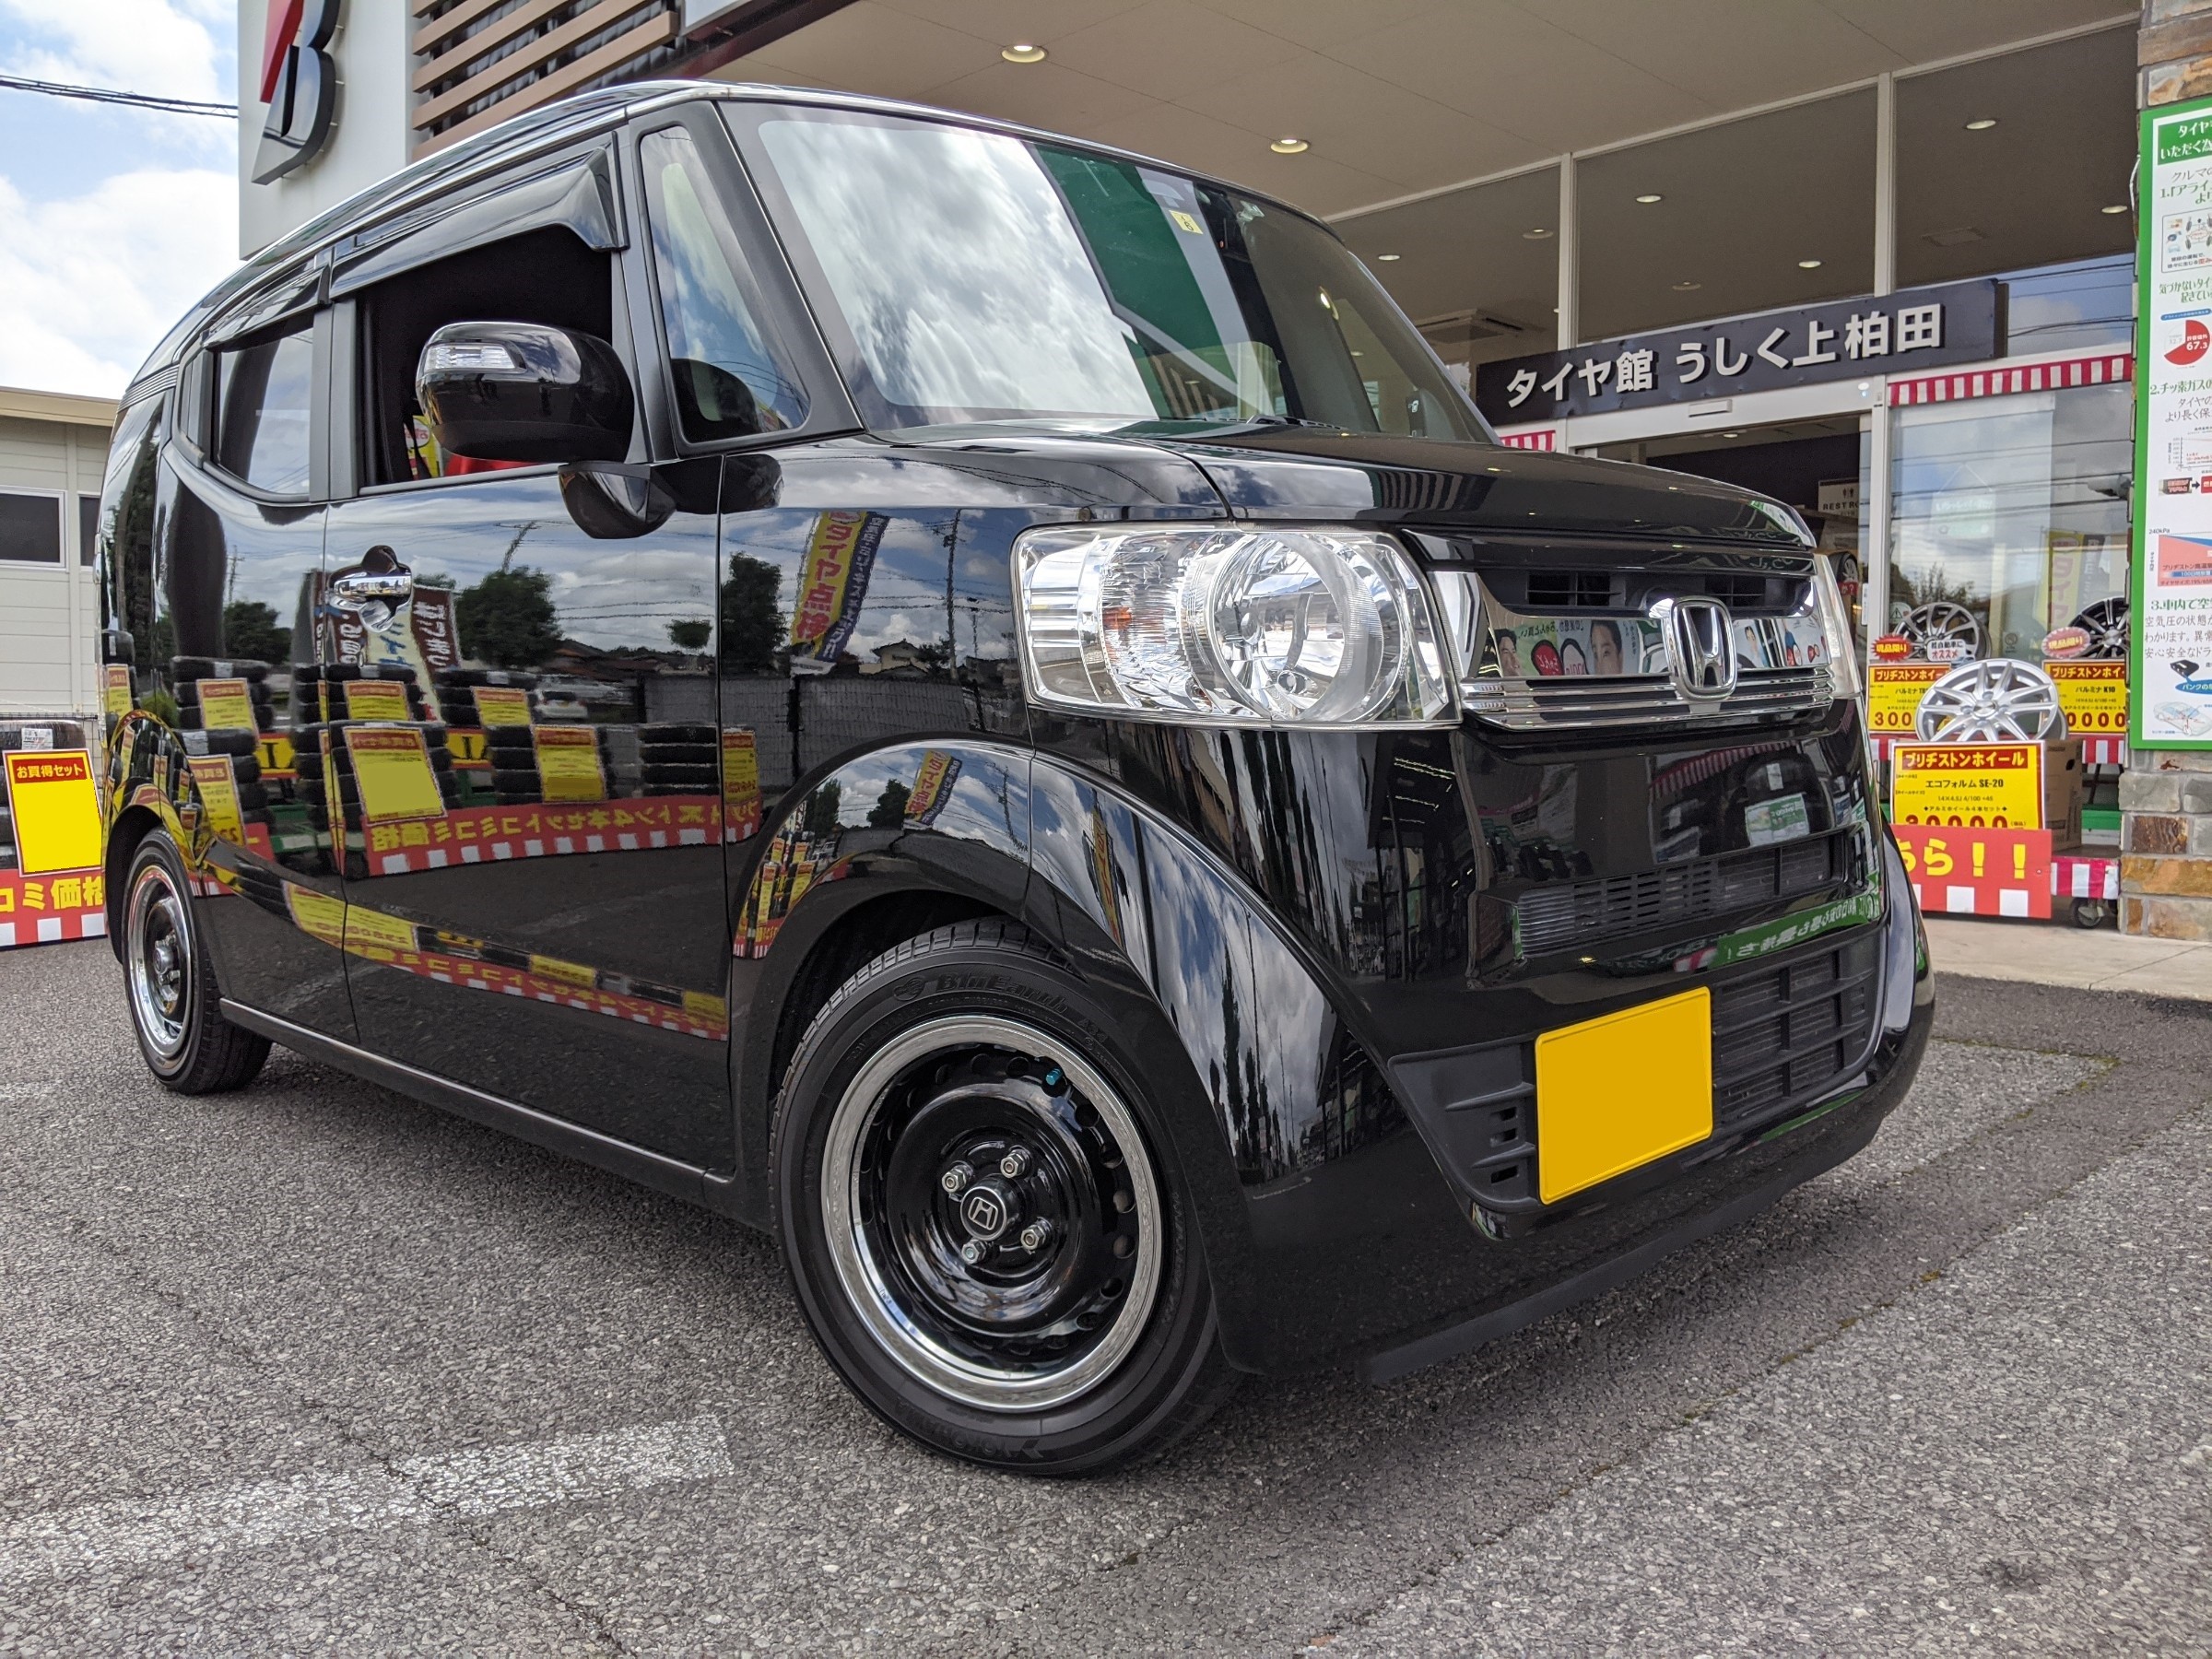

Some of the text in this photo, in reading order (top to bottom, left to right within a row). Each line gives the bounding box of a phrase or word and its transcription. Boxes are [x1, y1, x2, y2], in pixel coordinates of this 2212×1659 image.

[2179, 121, 2212, 138] タイヤ
[2160, 138, 2212, 159] いただく為
[2181, 290, 2212, 303] 起きてい
[2186, 341, 2208, 350] 67.3
[1506, 302, 1943, 408] タイヤ館 うしく上柏田
[17, 763, 84, 779] お買得セット
[1925, 779, 2004, 788] エコフォルム SE-20
